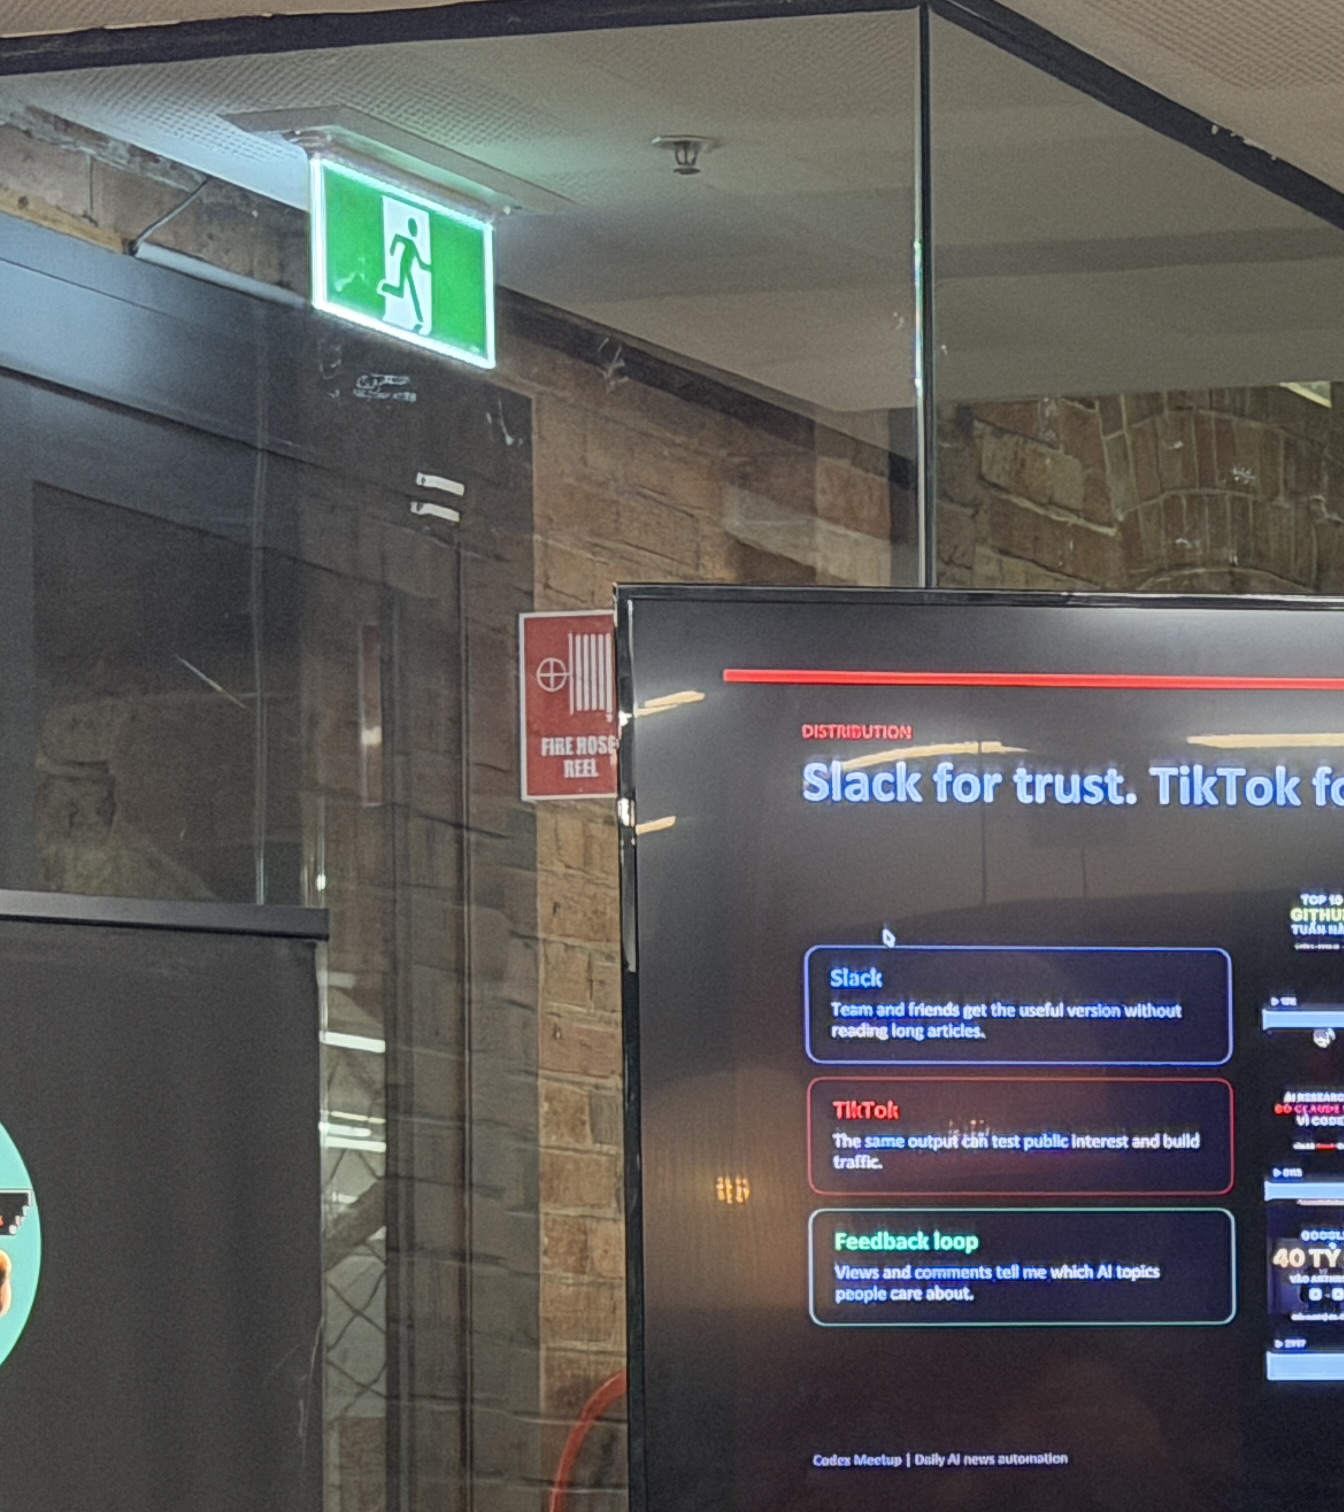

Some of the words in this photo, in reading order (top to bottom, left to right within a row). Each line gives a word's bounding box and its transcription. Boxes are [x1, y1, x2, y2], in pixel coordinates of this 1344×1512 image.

[801, 724, 913, 740] DISTRIBUTION
[541, 736, 574, 757] FIRE
[563, 758, 599, 779] REEL
[802, 761, 922, 802] Slack
[933, 763, 1003, 803] for
[1013, 766, 1138, 806] trust.
[1149, 764, 1302, 807] TikTok
[830, 966, 884, 988] Slack
[831, 1002, 873, 1018] Team
[876, 1002, 905, 1018] and
[908, 1002, 960, 1018] friends
[963, 1004, 988, 1021] get
[990, 1003, 1016, 1019] the
[1018, 1003, 1064, 1019] useful
[1066, 1003, 1122, 1019] version
[1123, 1003, 1183, 1019] without
[831, 1023, 889, 1041] reading
[891, 1023, 925, 1041] long
[927, 1023, 986, 1040] articles.
[832, 1100, 899, 1120] TikTok
[832, 1132, 862, 1149] The
[864, 1135, 905, 1149] same
[908, 1135, 959, 1152] output
[961, 1136, 989, 1150] can
[991, 1135, 1021, 1150] test
[1023, 1133, 1070, 1152] public
[1071, 1133, 1129, 1149] interest
[1131, 1133, 1161, 1149] and
[1162, 1133, 1200, 1149] build
[832, 1154, 883, 1170] traffic.
[834, 1231, 929, 1251] Feedback
[934, 1231, 979, 1253] loop
[1273, 1248, 1306, 1268] 40
[834, 1264, 880, 1280] Views
[882, 1264, 911, 1280] and
[914, 1266, 993, 1281] comments
[996, 1265, 1020, 1280] tell
[1022, 1267, 1047, 1280] me
[1051, 1265, 1094, 1280] which
[1096, 1265, 1113, 1280] AI
[1115, 1265, 1161, 1282] topics
[834, 1287, 887, 1304] people
[889, 1287, 923, 1301] care
[925, 1286, 975, 1302] about.
[812, 1453, 851, 1467] Codex
[853, 1453, 903, 1468] Meetup
[914, 1453, 945, 1468] Daily
[947, 1453, 961, 1466] AI
[963, 1455, 996, 1466] news
[997, 1453, 1069, 1466] automation
